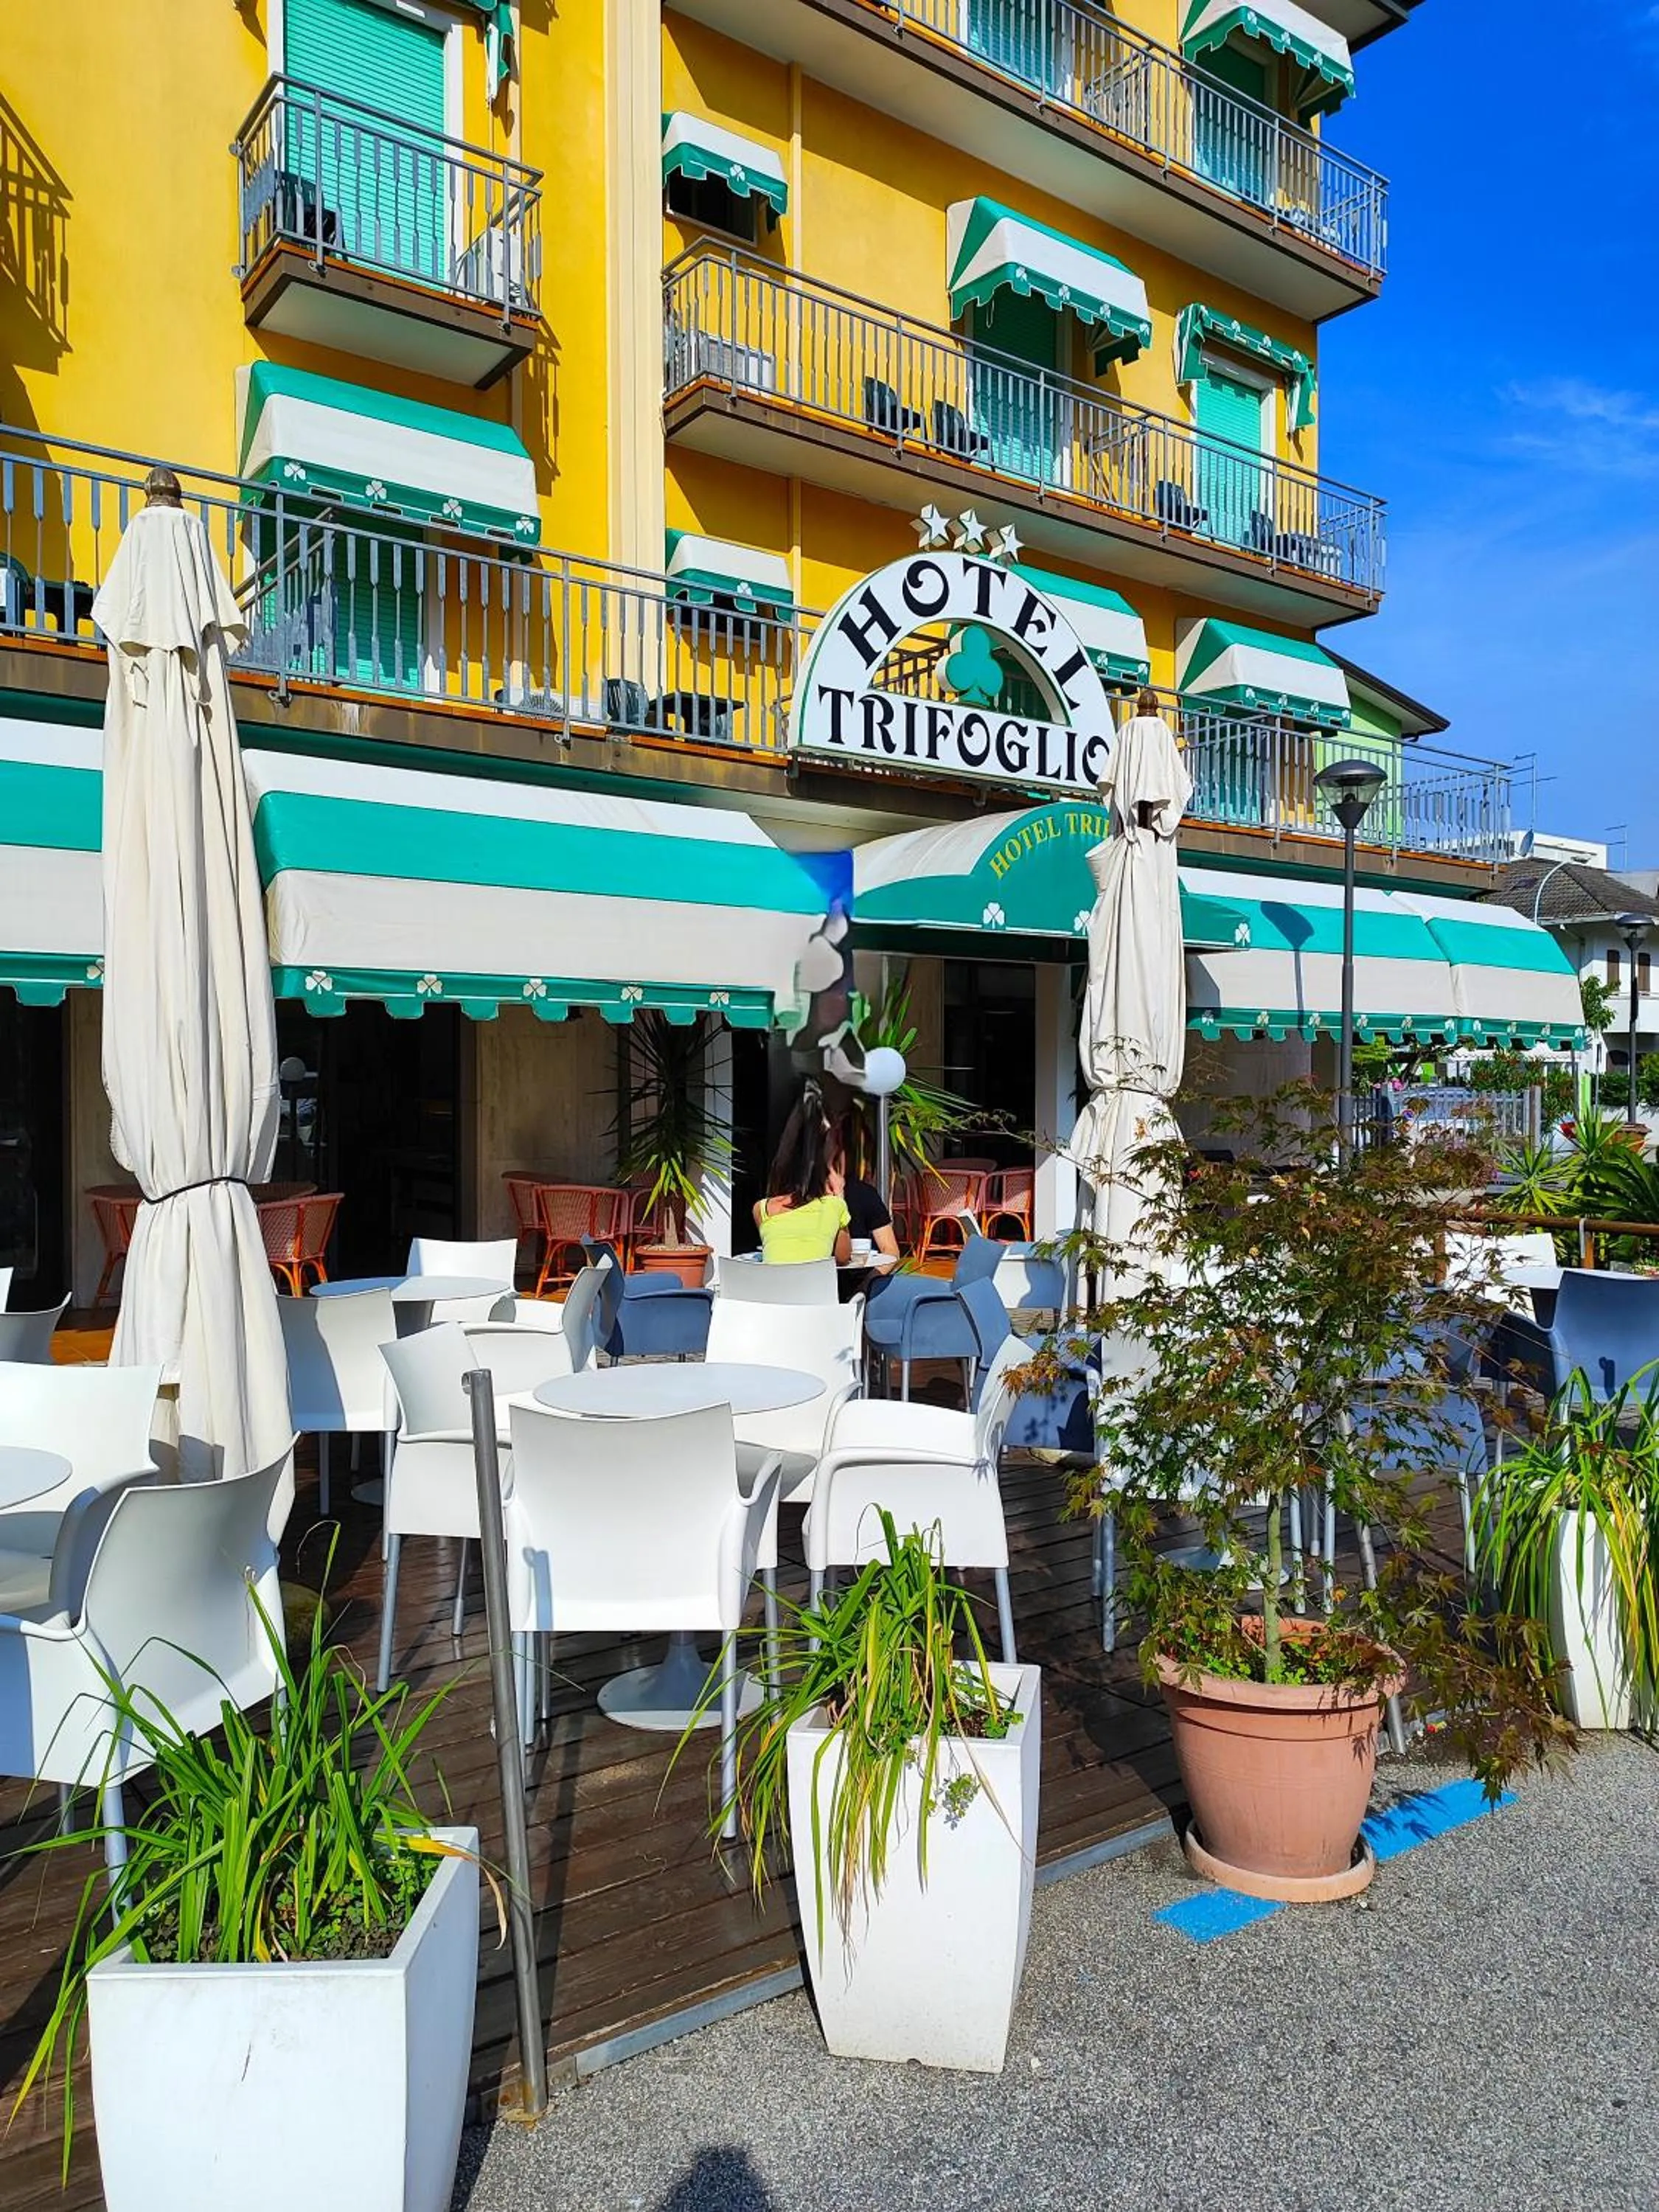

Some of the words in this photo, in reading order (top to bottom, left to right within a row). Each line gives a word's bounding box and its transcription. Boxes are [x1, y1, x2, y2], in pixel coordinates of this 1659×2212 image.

[838, 558, 1089, 710] HOTEL
[818, 684, 1110, 785] TRIFOGLIO
[990, 816, 1062, 879] HOTEL
